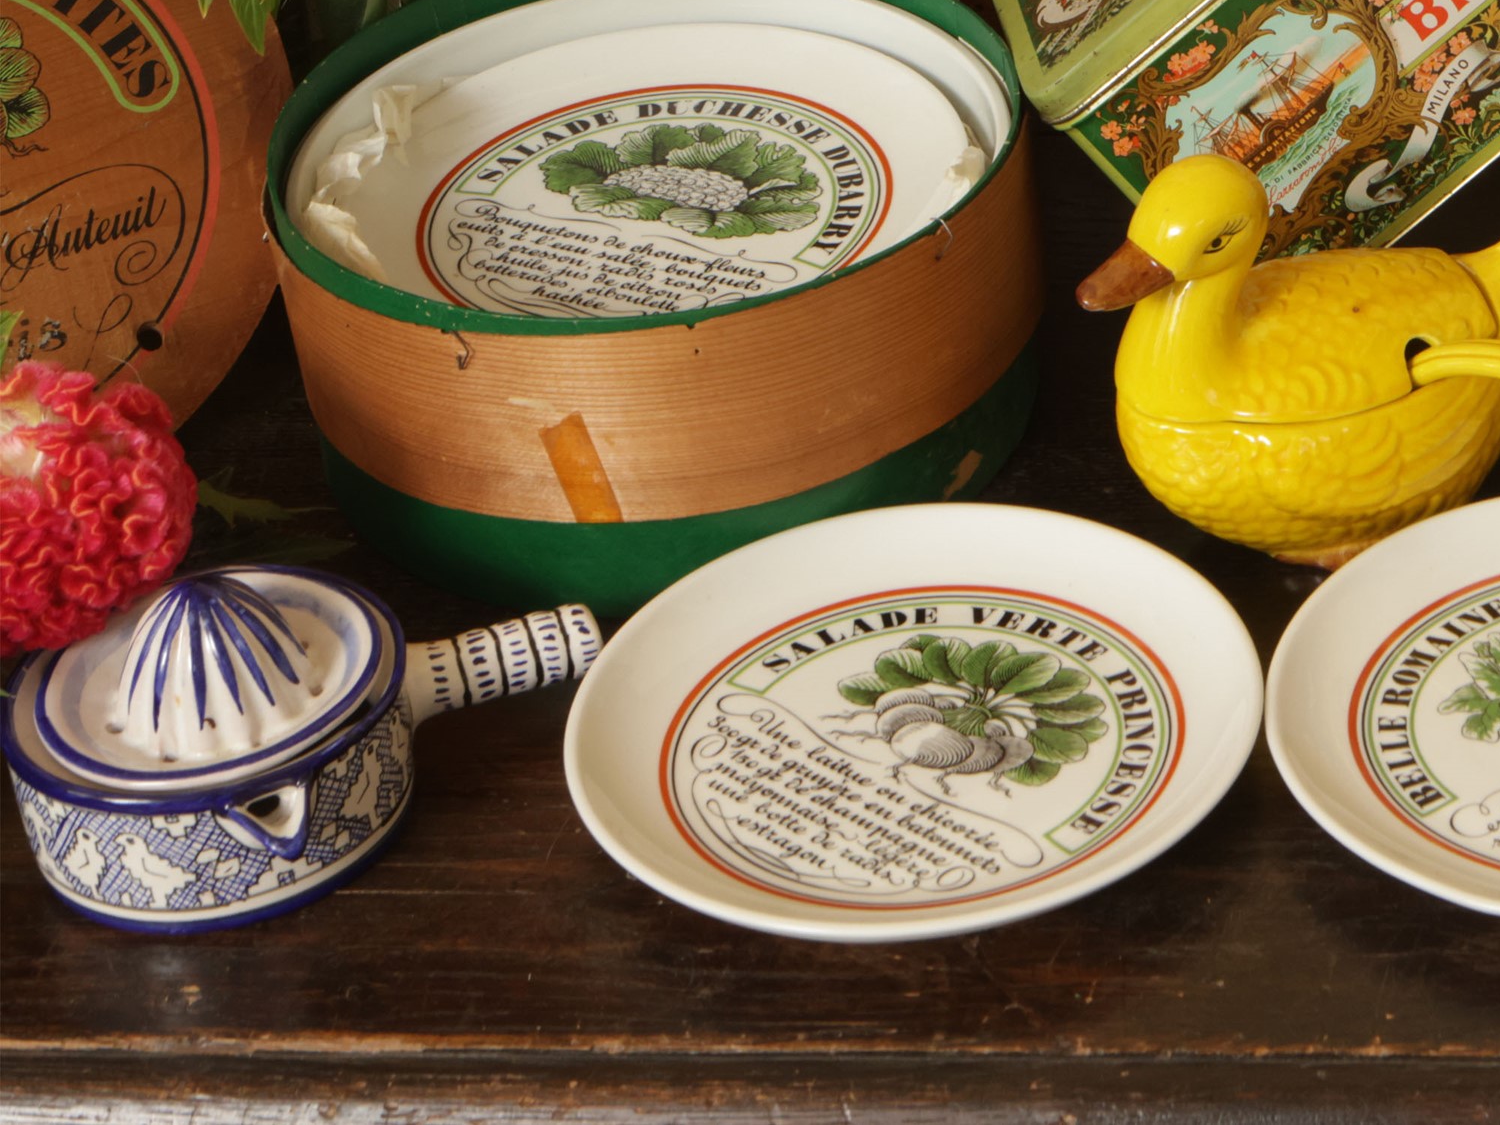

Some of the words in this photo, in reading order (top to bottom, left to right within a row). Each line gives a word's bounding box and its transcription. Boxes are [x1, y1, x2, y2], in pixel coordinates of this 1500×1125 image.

[1426, 58, 1470, 115] MILANO
[1246, 107, 1319, 168] ESPORTAZIONE
[1287, 143, 1324, 175] FABBRICA
[476, 110, 619, 183] SALADE
[636, 99, 832, 145] DUCHESSE
[820, 144, 865, 256] DUBARRY
[457, 220, 505, 237] cuits
[659, 263, 762, 291] bouquets
[475, 204, 599, 245] Bouquetons
[603, 235, 627, 250] de
[629, 242, 766, 279] choux-fleurs
[484, 236, 506, 250] de
[600, 262, 654, 281] radis
[661, 277, 717, 295] roses
[531, 286, 608, 310] hachée
[551, 265, 589, 281] jus
[592, 274, 616, 287] de
[620, 280, 682, 301] citron
[586, 285, 680, 312] ciboulette
[761, 606, 939, 673] SALADE
[969, 606, 1110, 663] VERTE
[1070, 668, 1157, 835] PRINCESSE
[713, 762, 840, 831] mayonnaise
[751, 709, 802, 749] Une
[805, 746, 874, 786] laitue
[876, 786, 908, 804] ou
[909, 802, 1000, 851] chicorée
[1378, 715, 1447, 809] BELLE
[708, 779, 749, 803] une
[755, 801, 807, 835] botte
[810, 830, 836, 850] de
[839, 848, 892, 879] radis
[736, 815, 829, 870] estragon
[760, 744, 783, 761] de
[779, 759, 863, 802] gruyère
[864, 801, 897, 820] en
[896, 813, 1001, 874] batonnets
[784, 777, 811, 796] de
[810, 795, 948, 866] champagne
